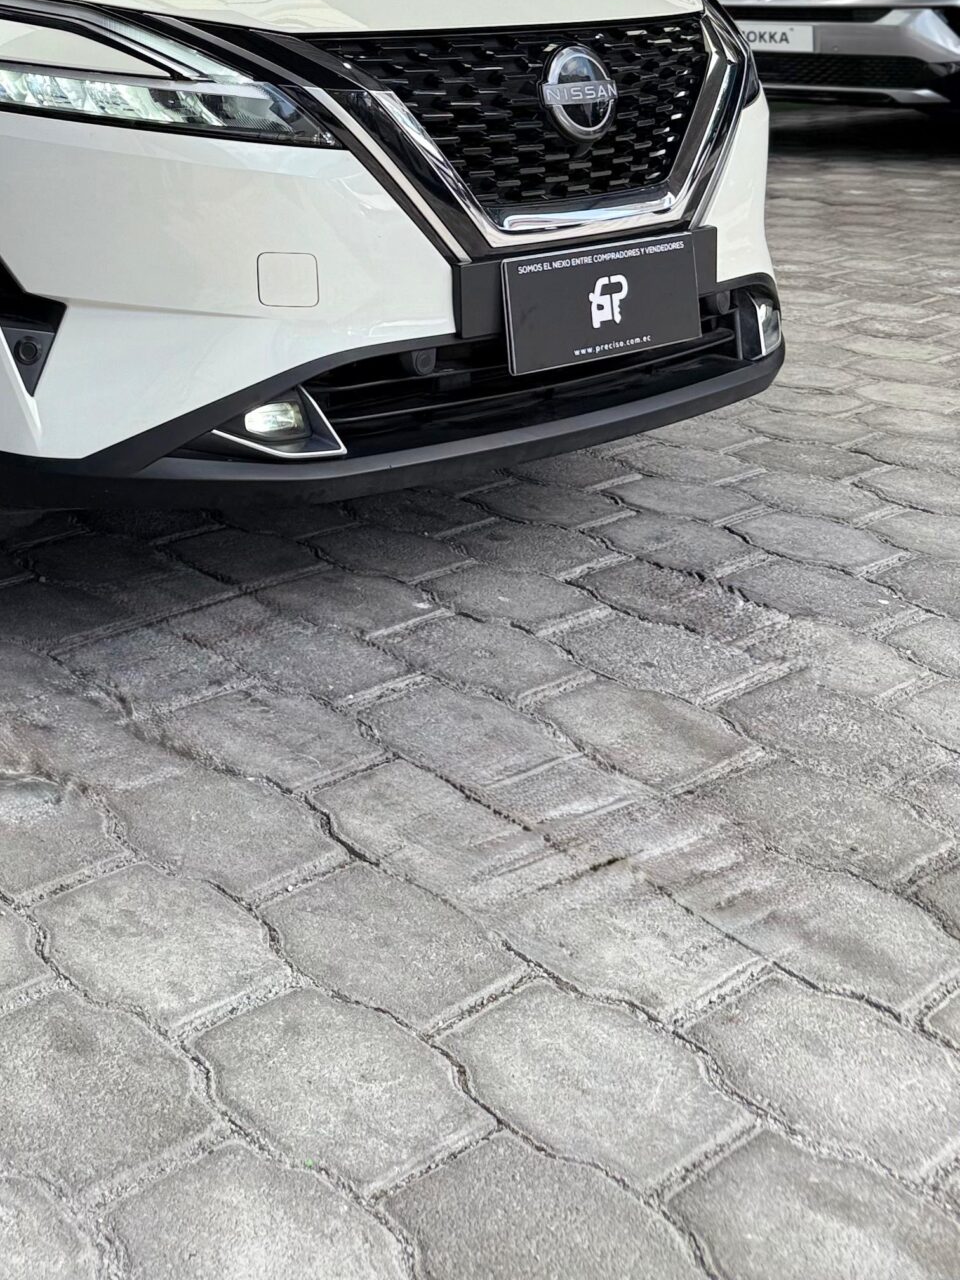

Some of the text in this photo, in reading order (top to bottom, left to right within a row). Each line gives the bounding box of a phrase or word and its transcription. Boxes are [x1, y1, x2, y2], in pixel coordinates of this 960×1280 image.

[741, 30, 790, 45] OKKA
[546, 83, 617, 101] NISSAN
[518, 241, 684, 274] SOMOS EL NEXO ENTRE COMPRADORES Y VENDEDORES
[574, 335, 651, 356] www.preciso.com.ec
